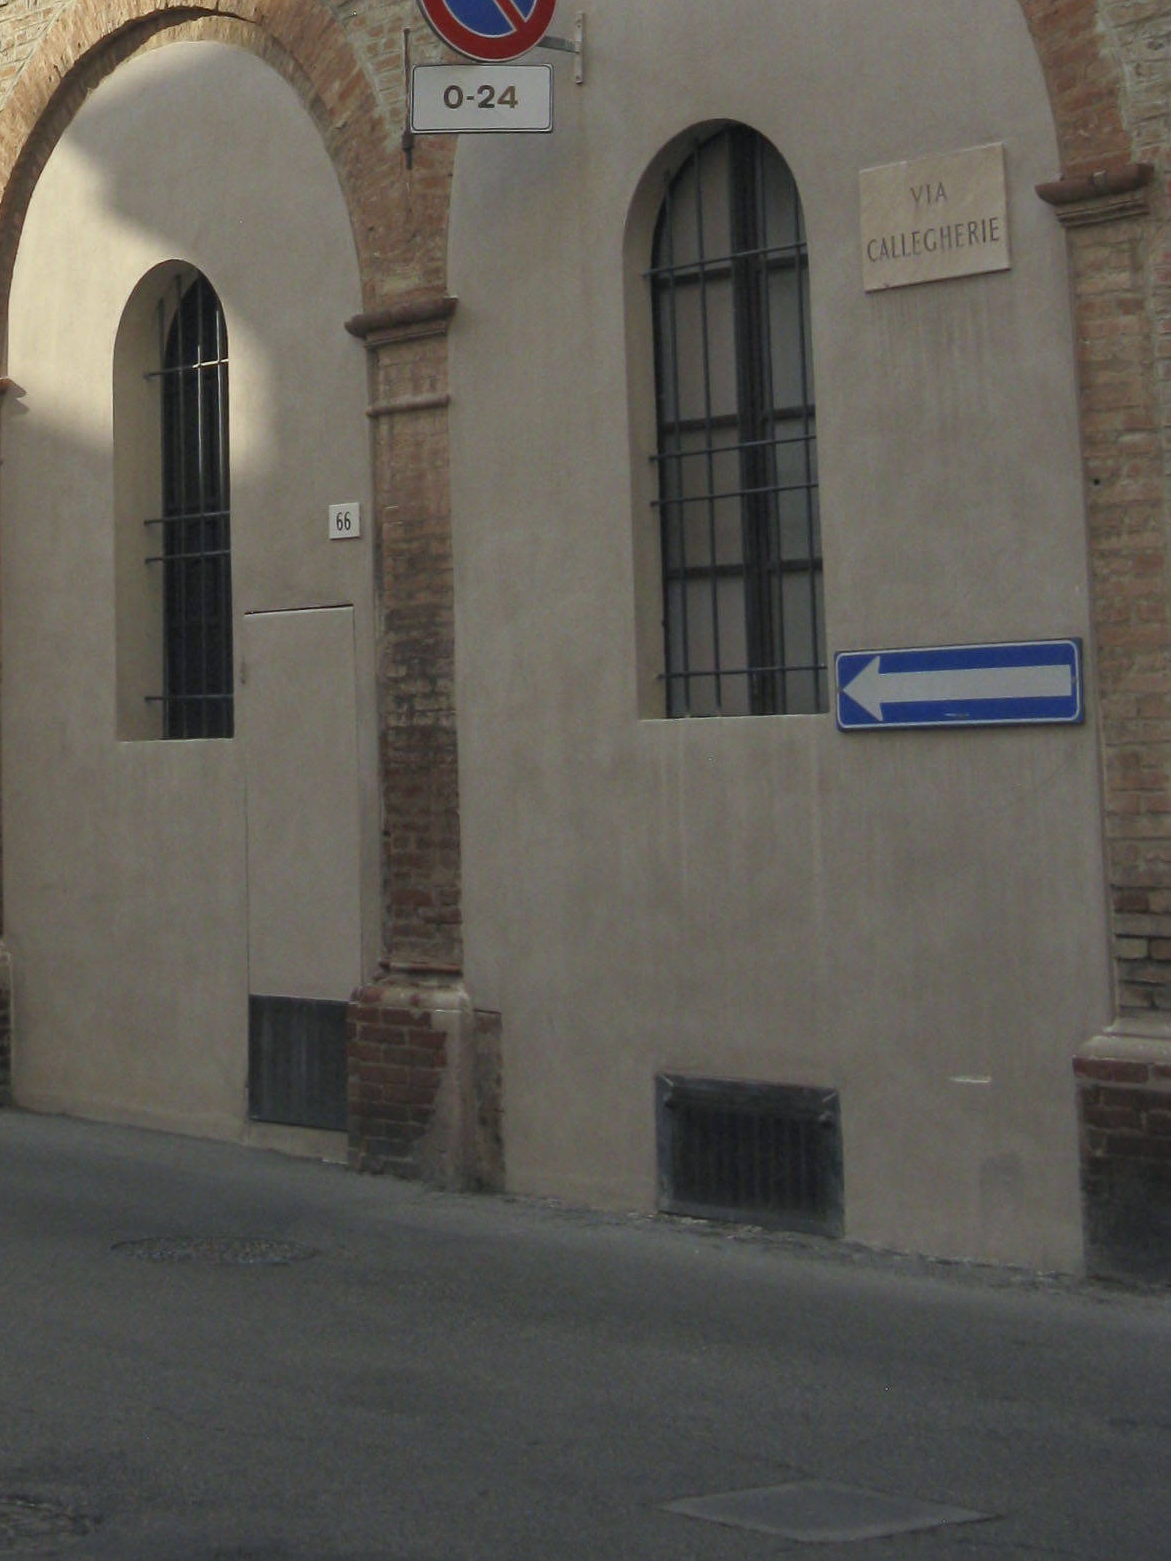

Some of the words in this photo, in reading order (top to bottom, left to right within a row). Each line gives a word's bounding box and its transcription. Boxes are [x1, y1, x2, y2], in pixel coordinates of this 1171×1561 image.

[443, 84, 519, 109] 0-24
[910, 181, 948, 205] VIA
[867, 217, 1000, 262] CALLEGHERIE
[336, 511, 351, 531] 66
